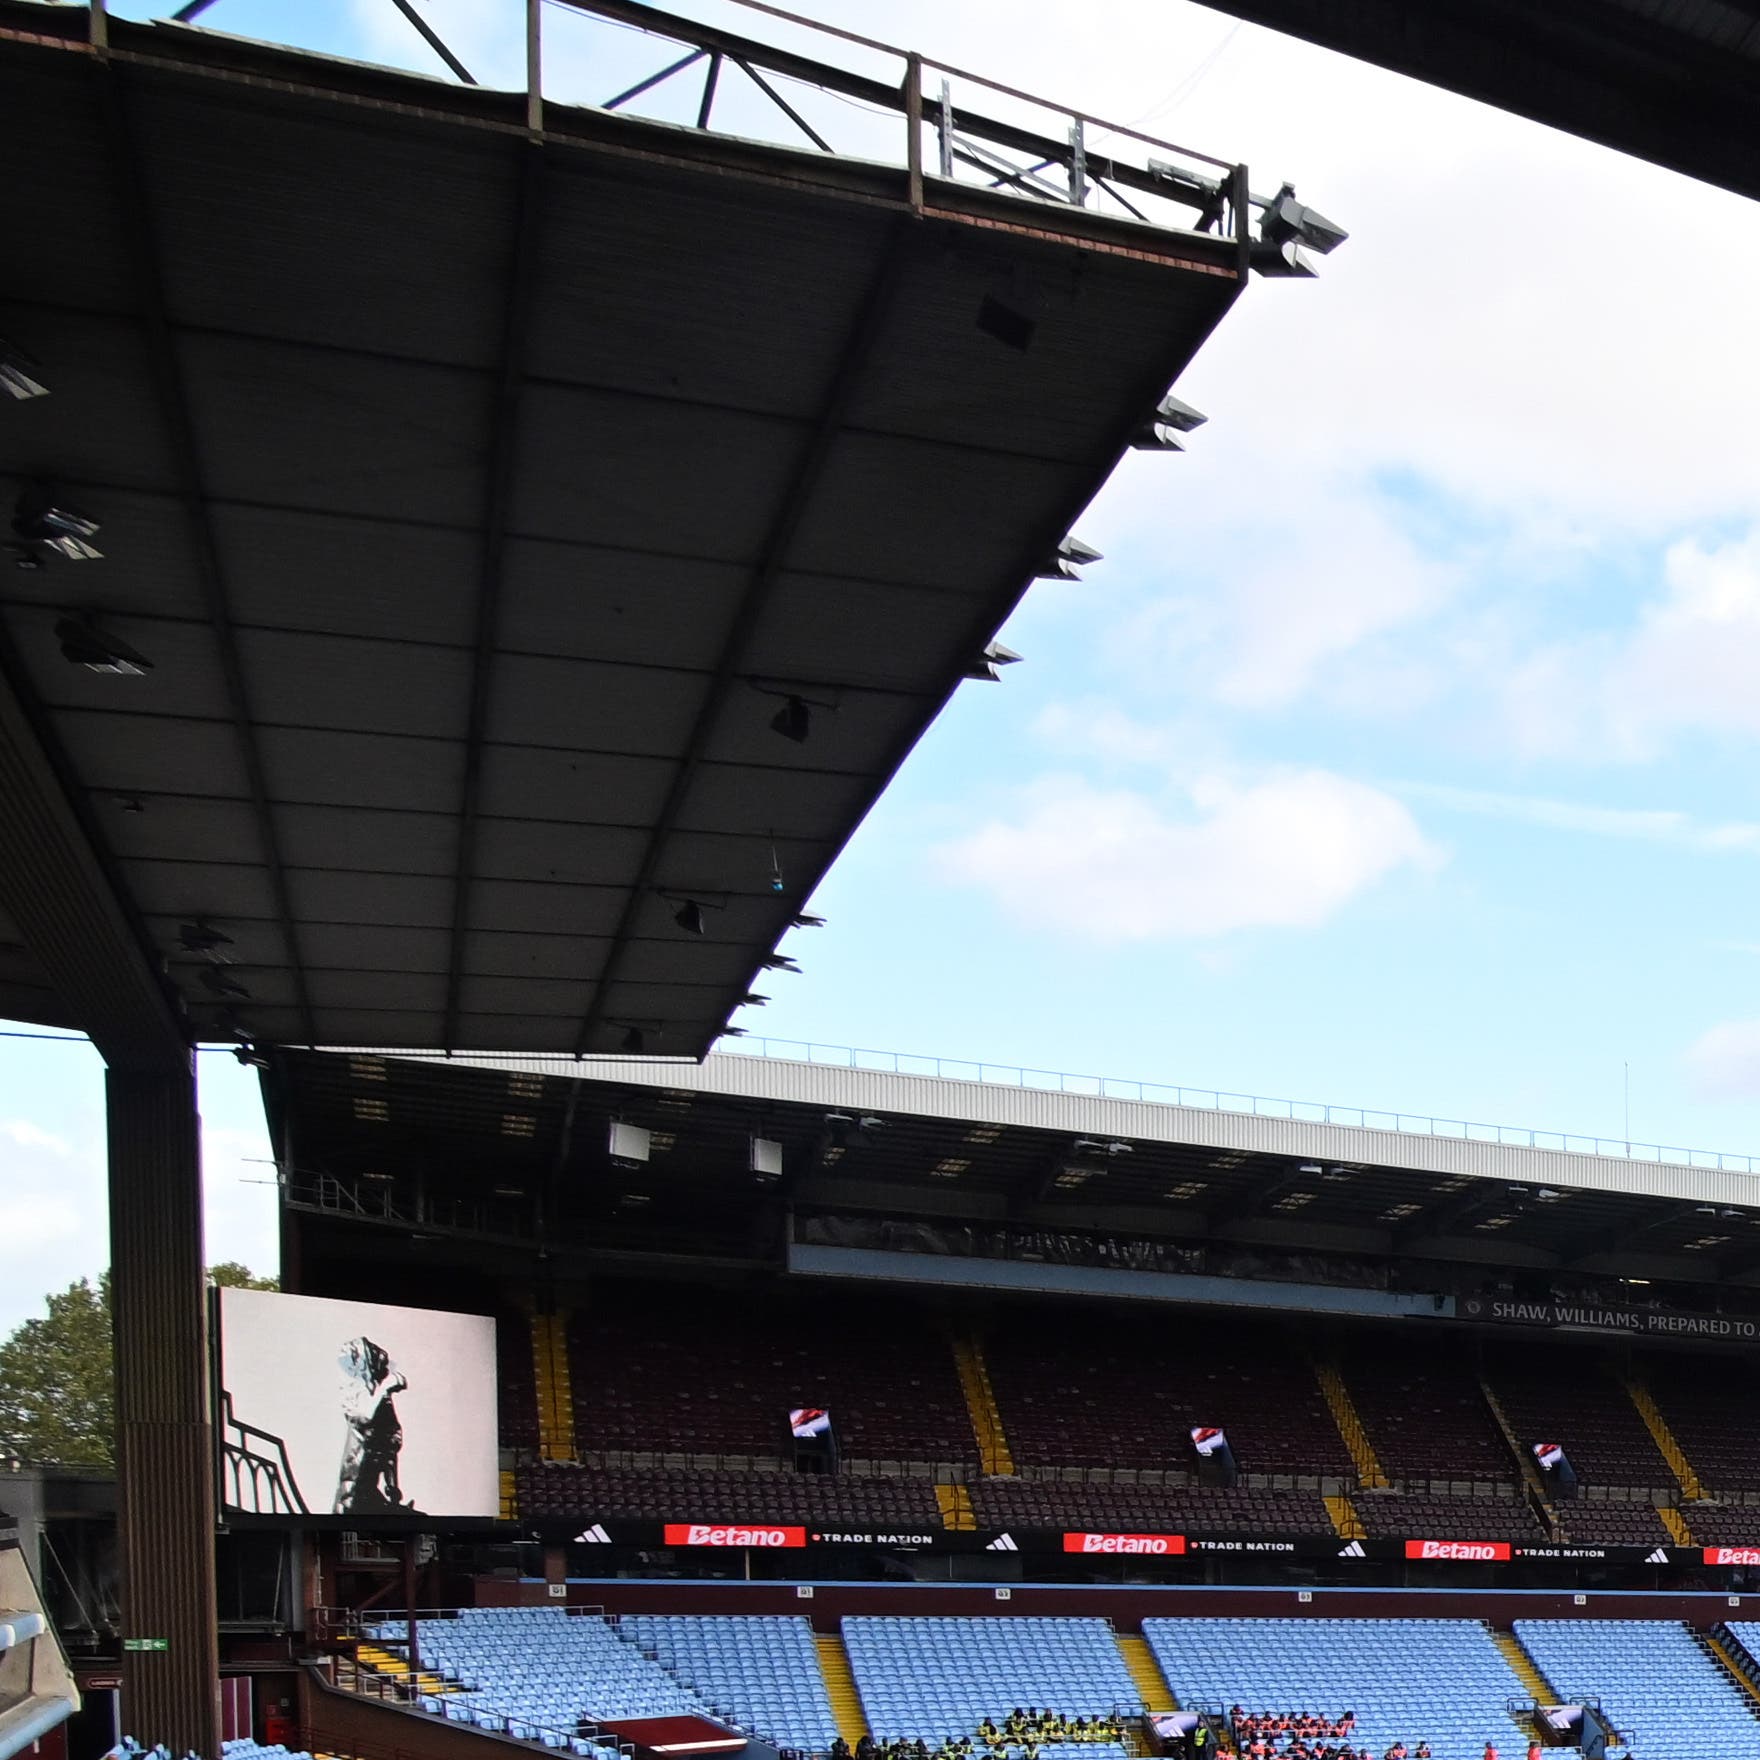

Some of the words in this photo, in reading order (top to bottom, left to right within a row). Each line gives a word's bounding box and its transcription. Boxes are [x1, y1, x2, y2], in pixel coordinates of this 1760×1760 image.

[1493, 1302, 1551, 1323] SHAW,
[1555, 1306, 1645, 1331] WILLIAMS,
[1649, 1315, 1730, 1335] PREPARED
[1735, 1321, 1755, 1337] TO
[687, 1525, 785, 1547] Betano
[823, 1533, 872, 1543] TRADE
[877, 1535, 933, 1545] NATION
[1083, 1534, 1168, 1554] Betano
[1200, 1542, 1242, 1551] TRADE
[1247, 1543, 1294, 1552] NATION
[1421, 1541, 1495, 1560] Betano
[1523, 1548, 1560, 1557] TRADE
[1563, 1549, 1605, 1558] NATION
